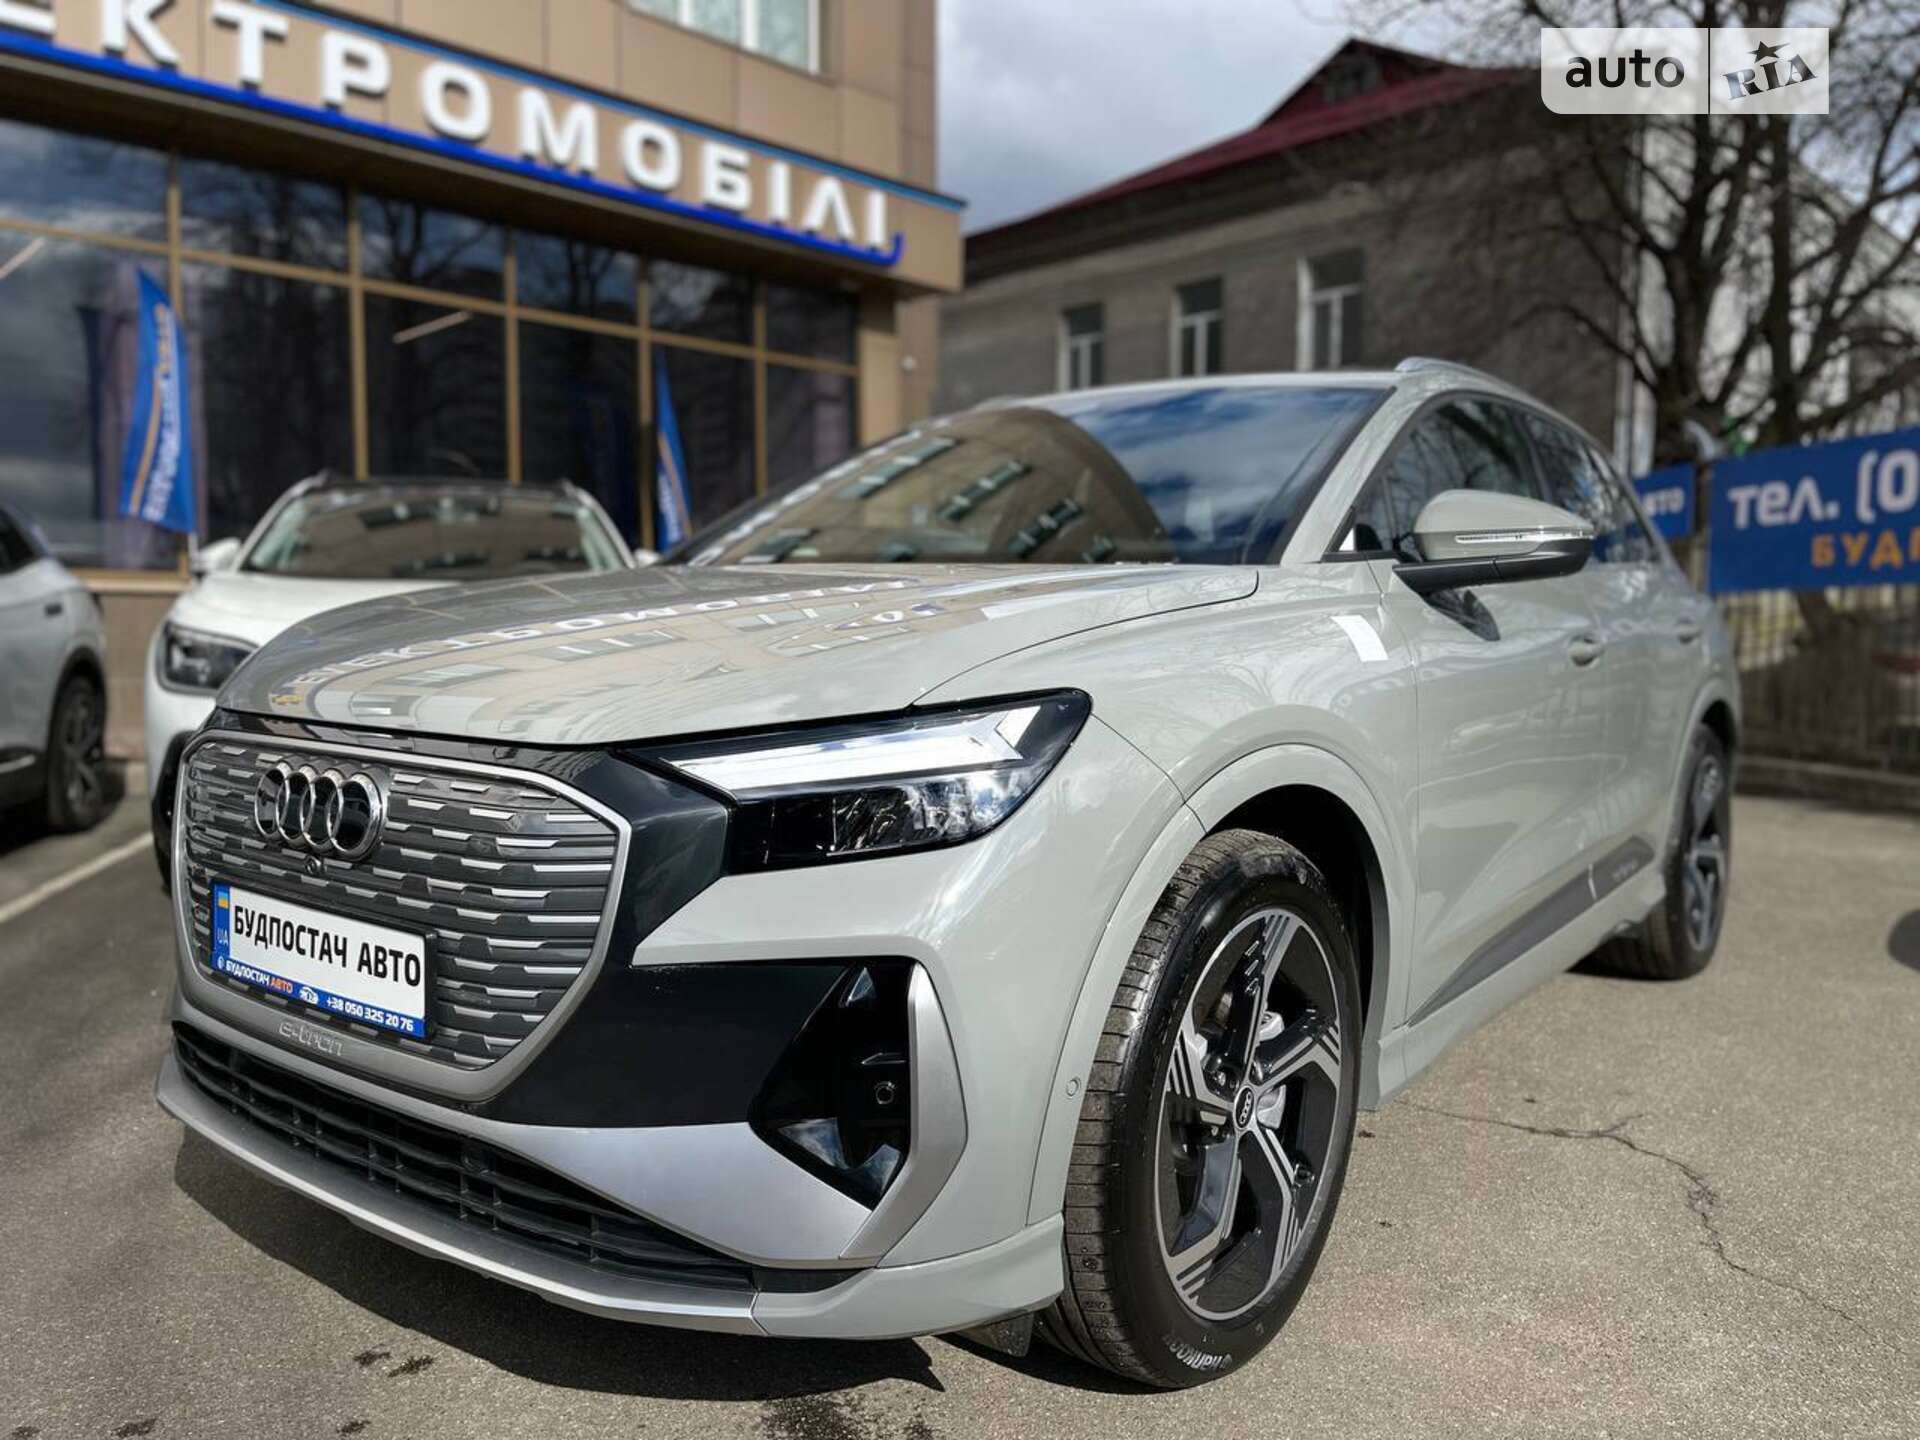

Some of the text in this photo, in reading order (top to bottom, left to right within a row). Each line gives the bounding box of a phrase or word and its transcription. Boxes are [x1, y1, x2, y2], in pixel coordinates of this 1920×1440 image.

[235, 905, 421, 987] БУДПОСТАЧ АВТО
[327, 996, 344, 1012] +38
[345, 1001, 363, 1017] 050
[365, 1007, 384, 1024] 325
[385, 1013, 399, 1028] 20
[400, 1017, 414, 1032] 76
[279, 1021, 343, 1057] e-tron
